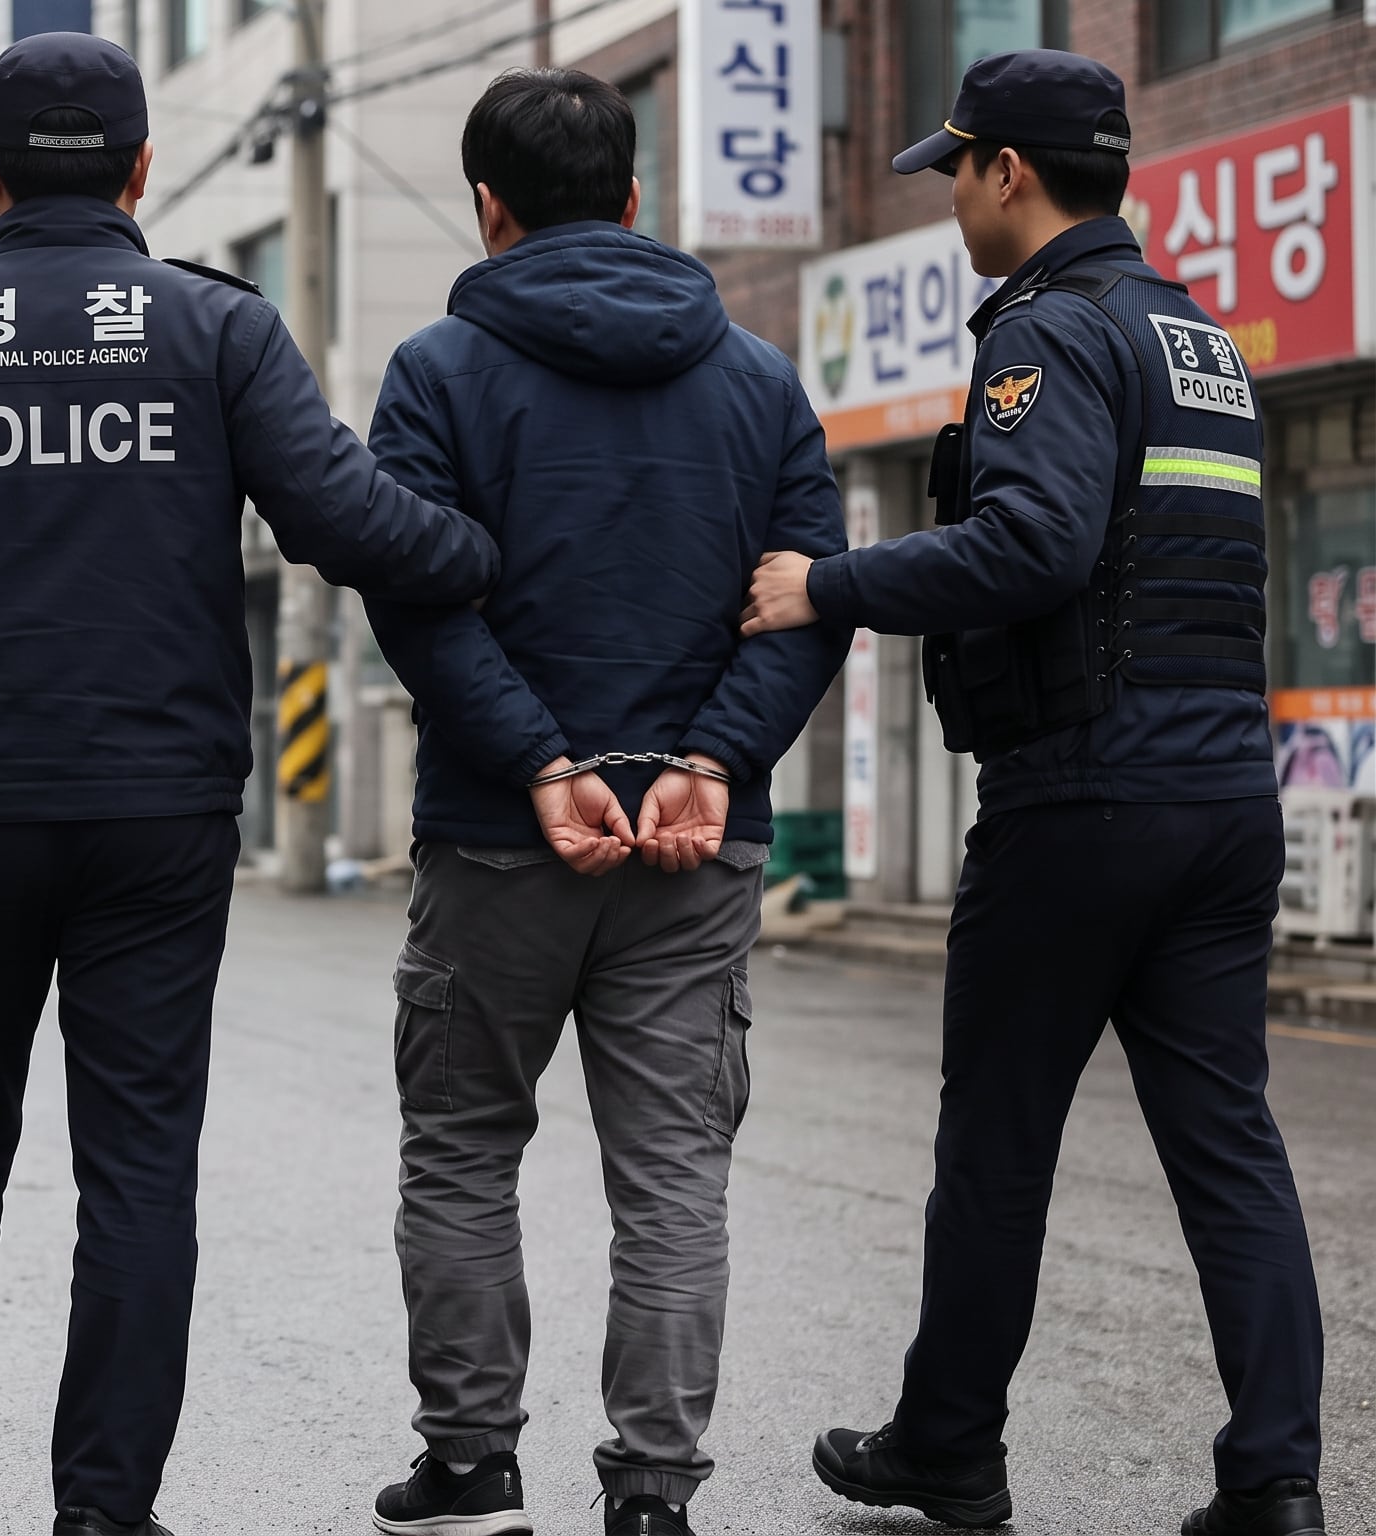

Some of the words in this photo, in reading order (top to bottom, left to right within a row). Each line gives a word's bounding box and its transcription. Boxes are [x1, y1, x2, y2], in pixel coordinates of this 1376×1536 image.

[1164, 132, 1338, 313] 식당
[33, 349, 85, 366] POLICE
[89, 347, 149, 364] AGENCY
[865, 253, 1000, 383] 편의
[1179, 376, 1247, 408] POLICE
